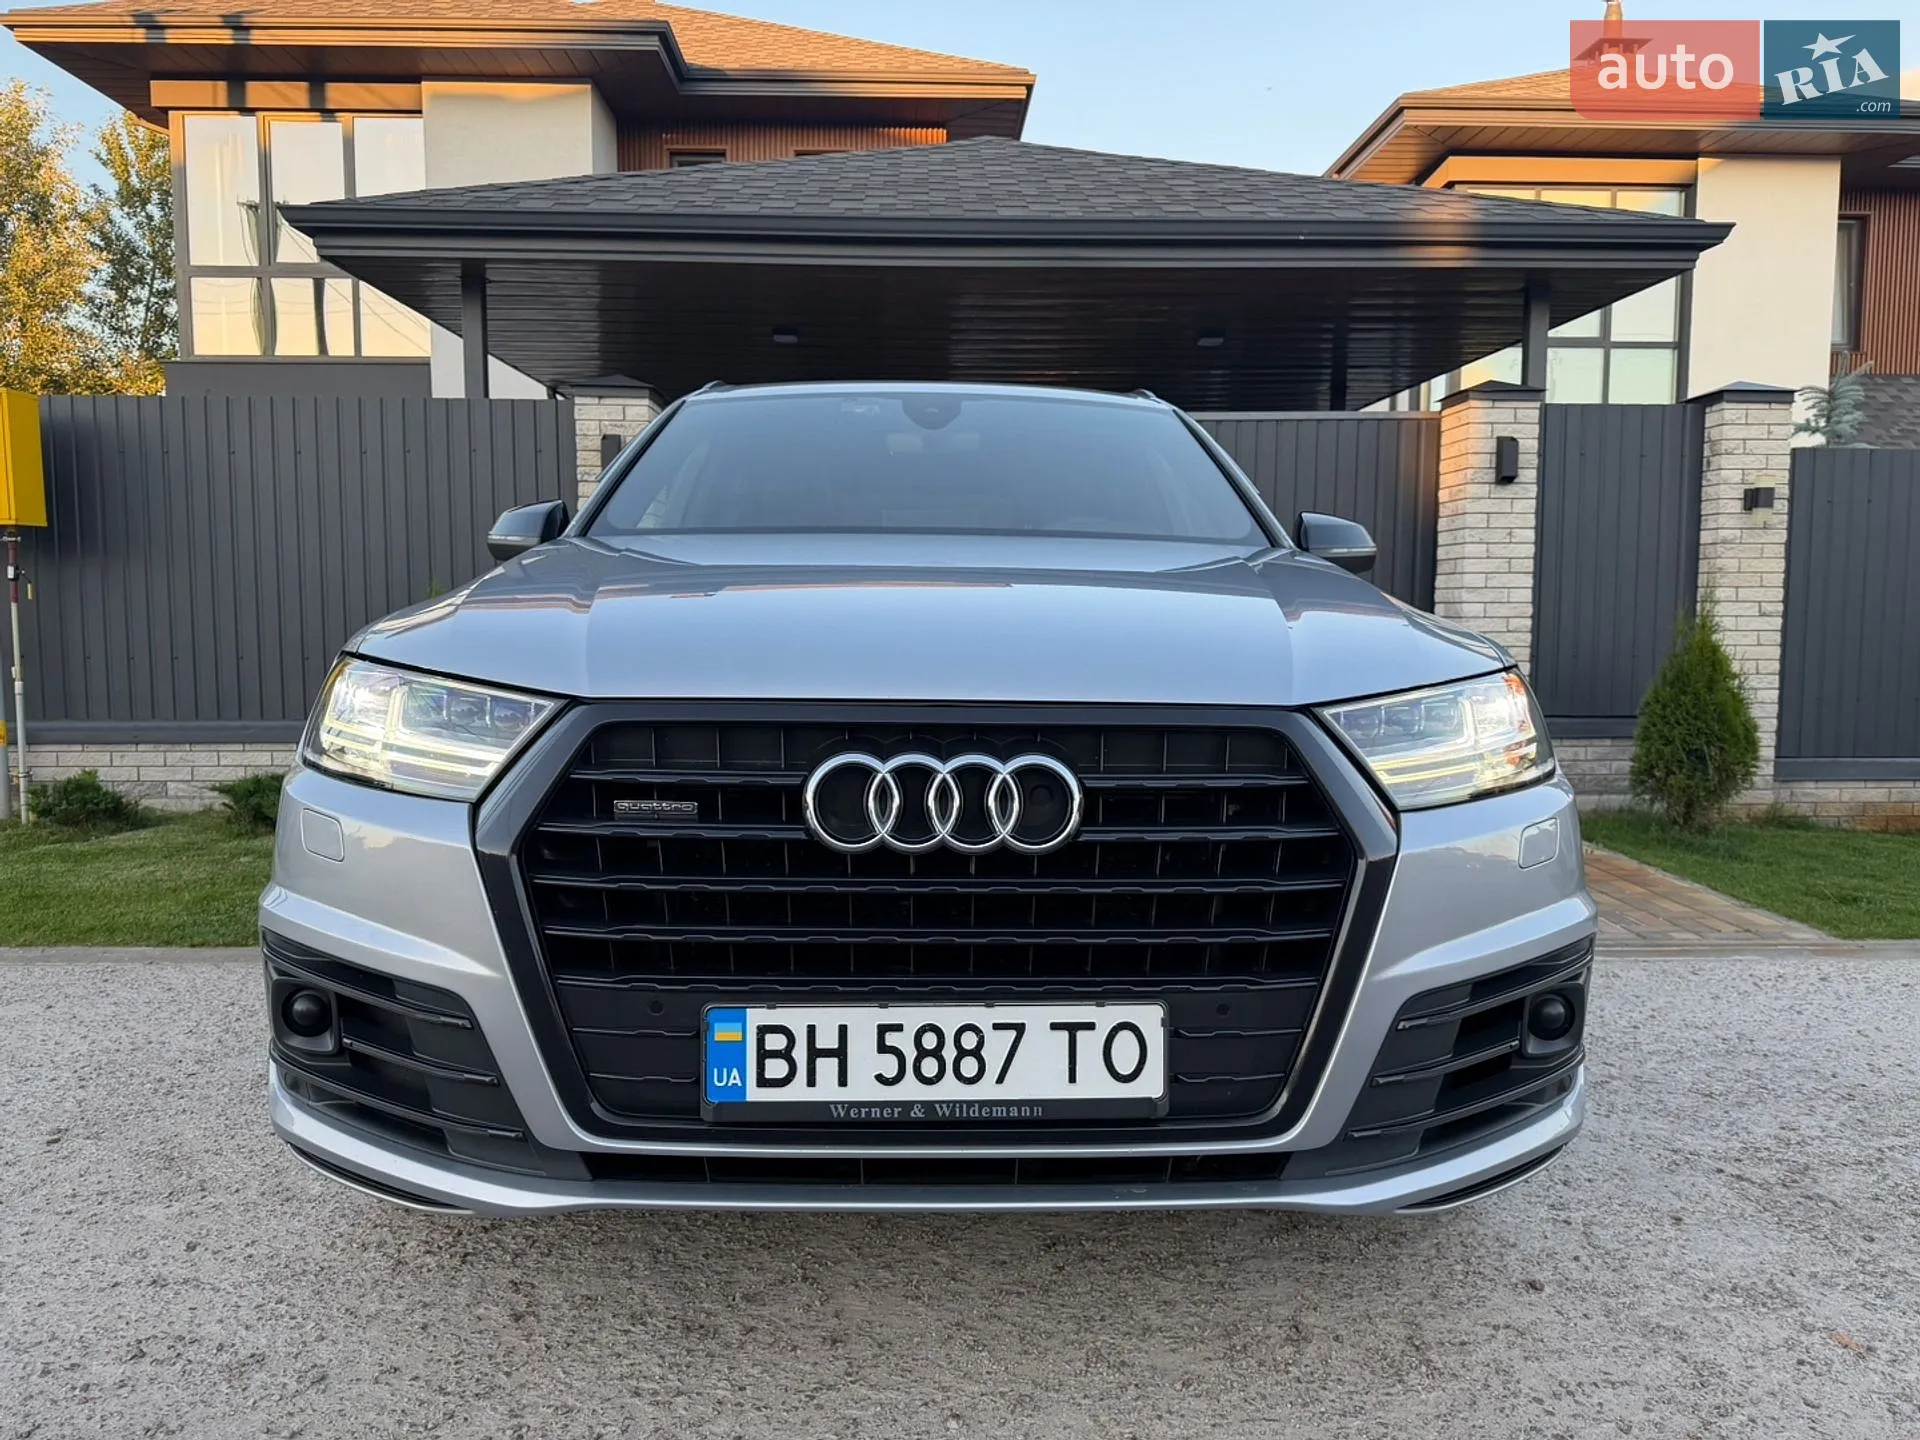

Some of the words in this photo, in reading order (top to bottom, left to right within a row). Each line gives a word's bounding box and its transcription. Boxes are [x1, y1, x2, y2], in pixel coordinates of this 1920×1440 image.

[617, 802, 694, 813] quattro
[756, 1023, 848, 1088] BH
[873, 1022, 1027, 1086] 5887
[1049, 1020, 1148, 1084] TO
[713, 1067, 742, 1088] UA
[830, 1103, 903, 1119] Werner
[911, 1104, 926, 1118] &
[934, 1103, 1043, 1118] Wildemann
